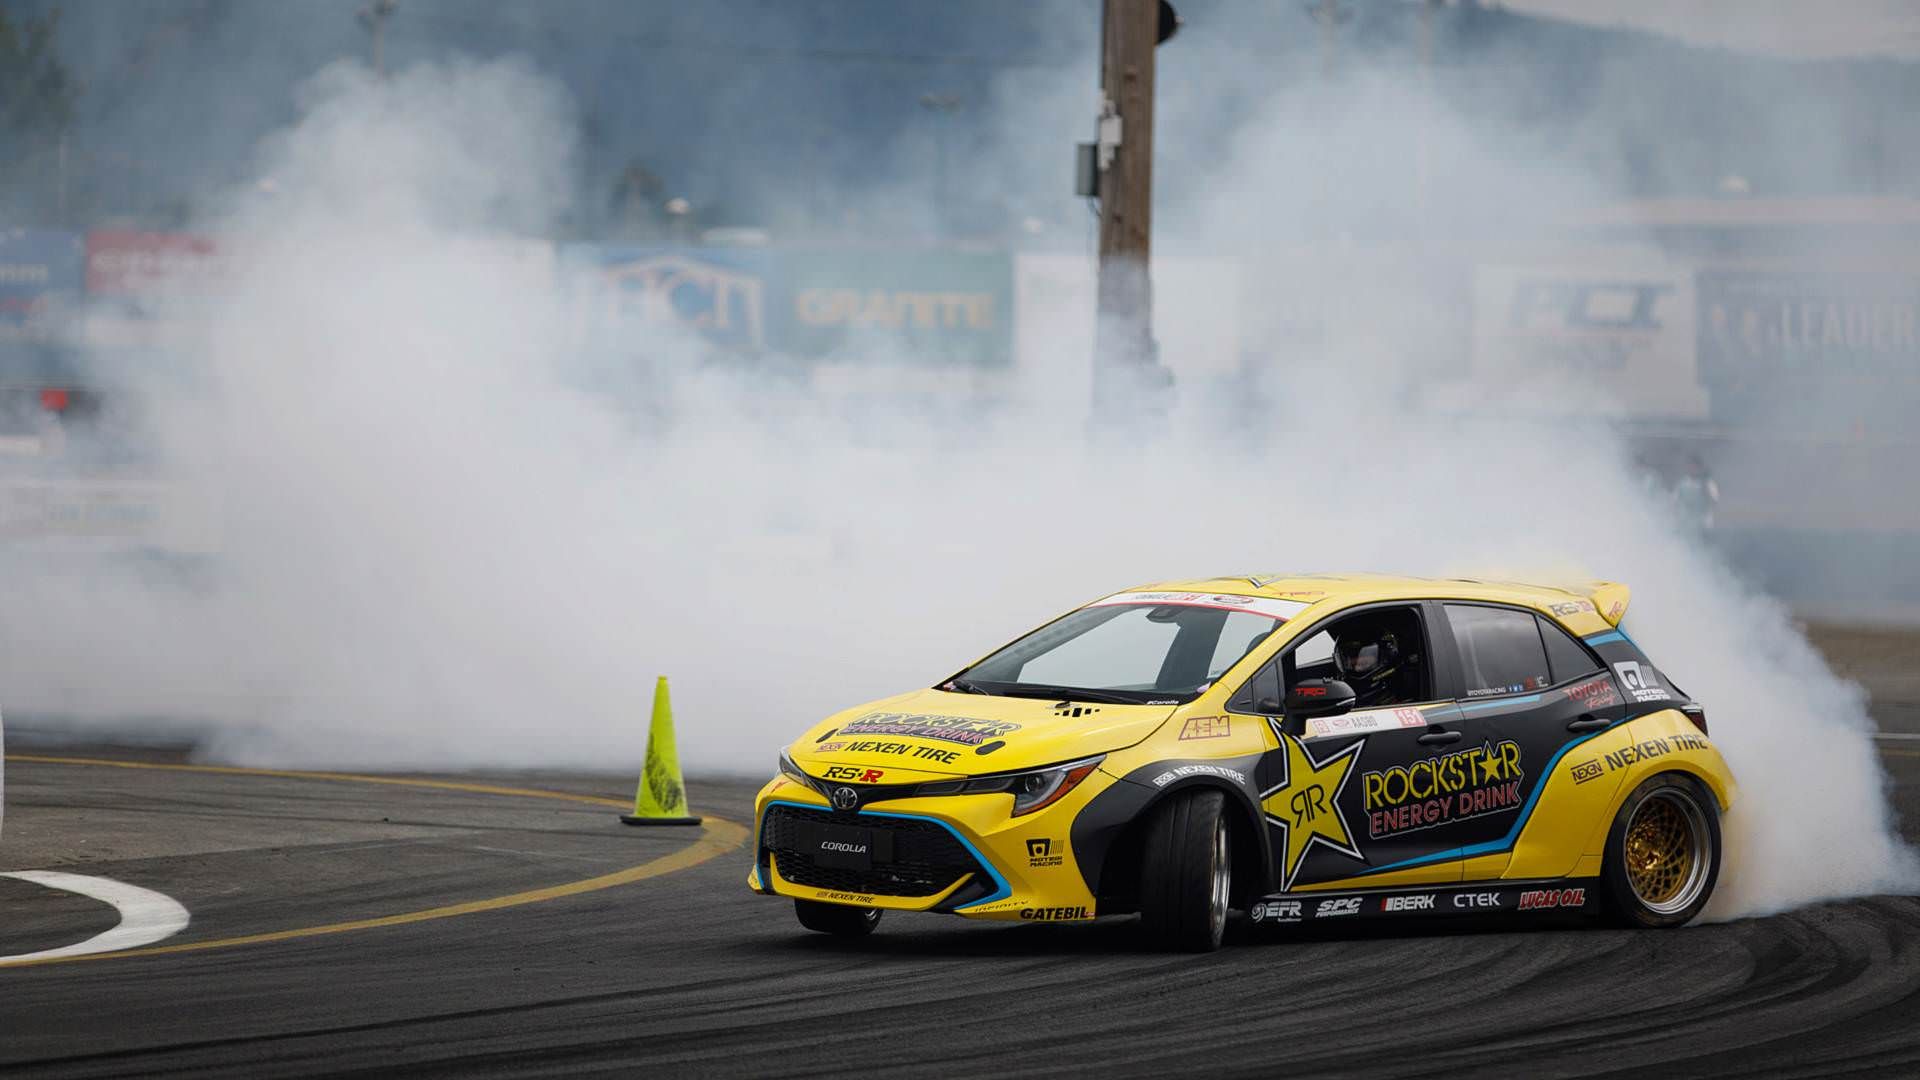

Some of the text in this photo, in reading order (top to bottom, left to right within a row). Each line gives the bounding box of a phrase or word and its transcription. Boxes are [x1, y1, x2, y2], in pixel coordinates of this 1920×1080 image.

[796, 289, 994, 328] GRANITE
[1295, 686, 1327, 697] TRD
[1563, 680, 1613, 702] TOYOTA
[1398, 708, 1422, 726] 151
[845, 741, 913, 756] NEXEN
[912, 746, 962, 764] TIRE
[1605, 737, 1673, 772] NEXEN
[1674, 731, 1709, 751] TIRE
[1173, 765, 1218, 777] NEXEN
[1216, 767, 1246, 785] TIRE
[1370, 781, 1520, 834] ENERGY DRINK
[820, 841, 867, 854] COROLLA
[1317, 896, 1364, 911] SPC
[1393, 894, 1436, 911] BERK
[1453, 892, 1501, 908] CTEK
[1518, 888, 1586, 910] LUCAS OIL
[1020, 907, 1088, 920] GATEBIL
[1265, 901, 1303, 918] EFR
